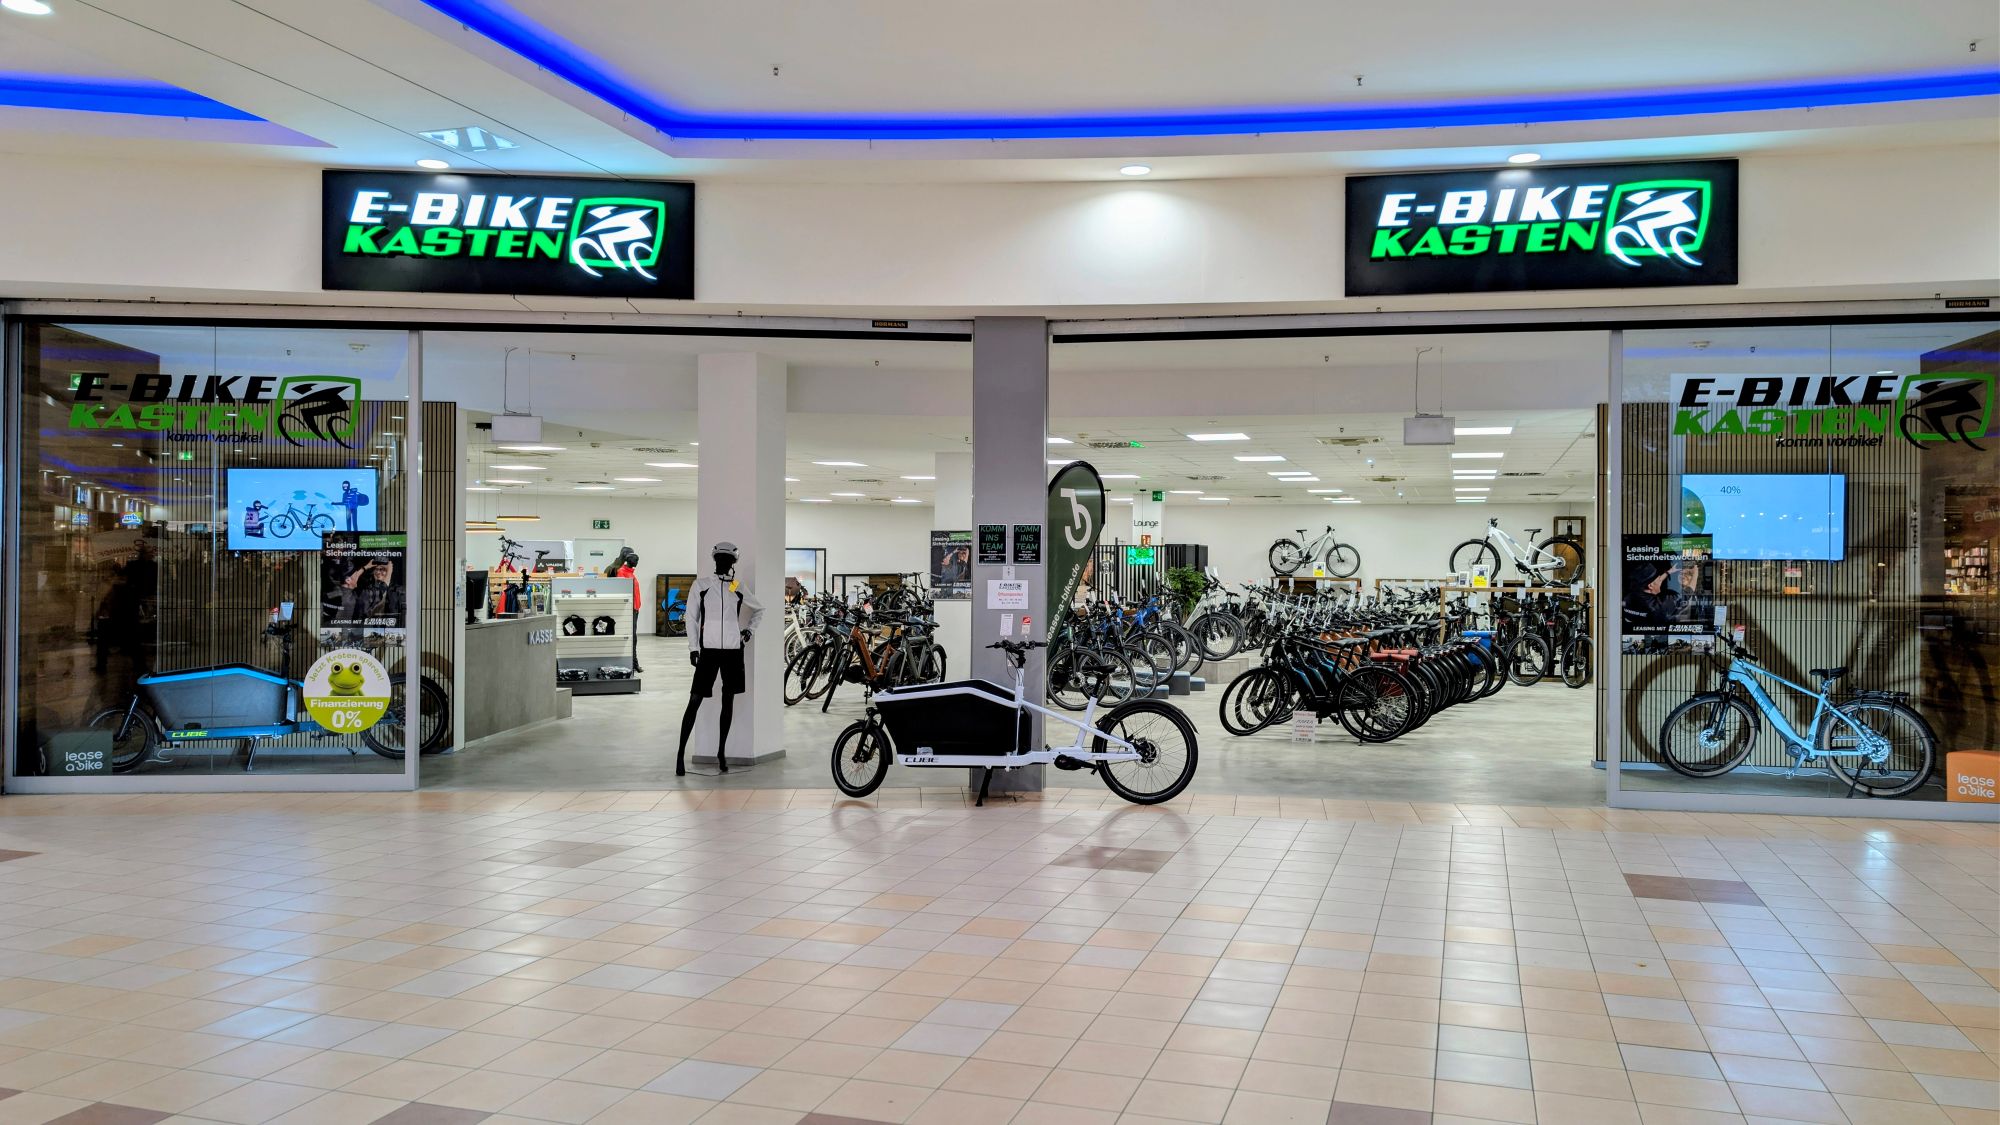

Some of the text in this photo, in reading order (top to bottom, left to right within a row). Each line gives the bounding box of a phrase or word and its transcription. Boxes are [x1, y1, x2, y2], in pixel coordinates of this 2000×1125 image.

[349, 191, 574, 229] E-BIKE
[1376, 184, 1609, 227] E-BIKE
[343, 225, 565, 259] KASTEN
[1370, 220, 1600, 258] KASTEN
[74, 373, 277, 403] E-BIKE
[1679, 375, 1898, 407] E-BIKE
[68, 403, 269, 431] KASTEN
[1673, 407, 1889, 435] KASTEN
[166, 431, 207, 442] komm
[1776, 436, 1823, 447] komm
[1720, 485, 1741, 494] 40%
[1133, 520, 1159, 528] Lounge
[326, 541, 357, 550] Leasing
[326, 549, 402, 557] Sicherheitswochen
[1626, 545, 1659, 553] Leasing
[529, 629, 553, 645] KASSE
[309, 662, 326, 682] Jetzt
[359, 656, 385, 681] sparen!
[310, 699, 384, 710] Finanzierung
[331, 710, 362, 728] 0%
[65, 751, 103, 761] lease
[1958, 772, 1996, 787] lease
